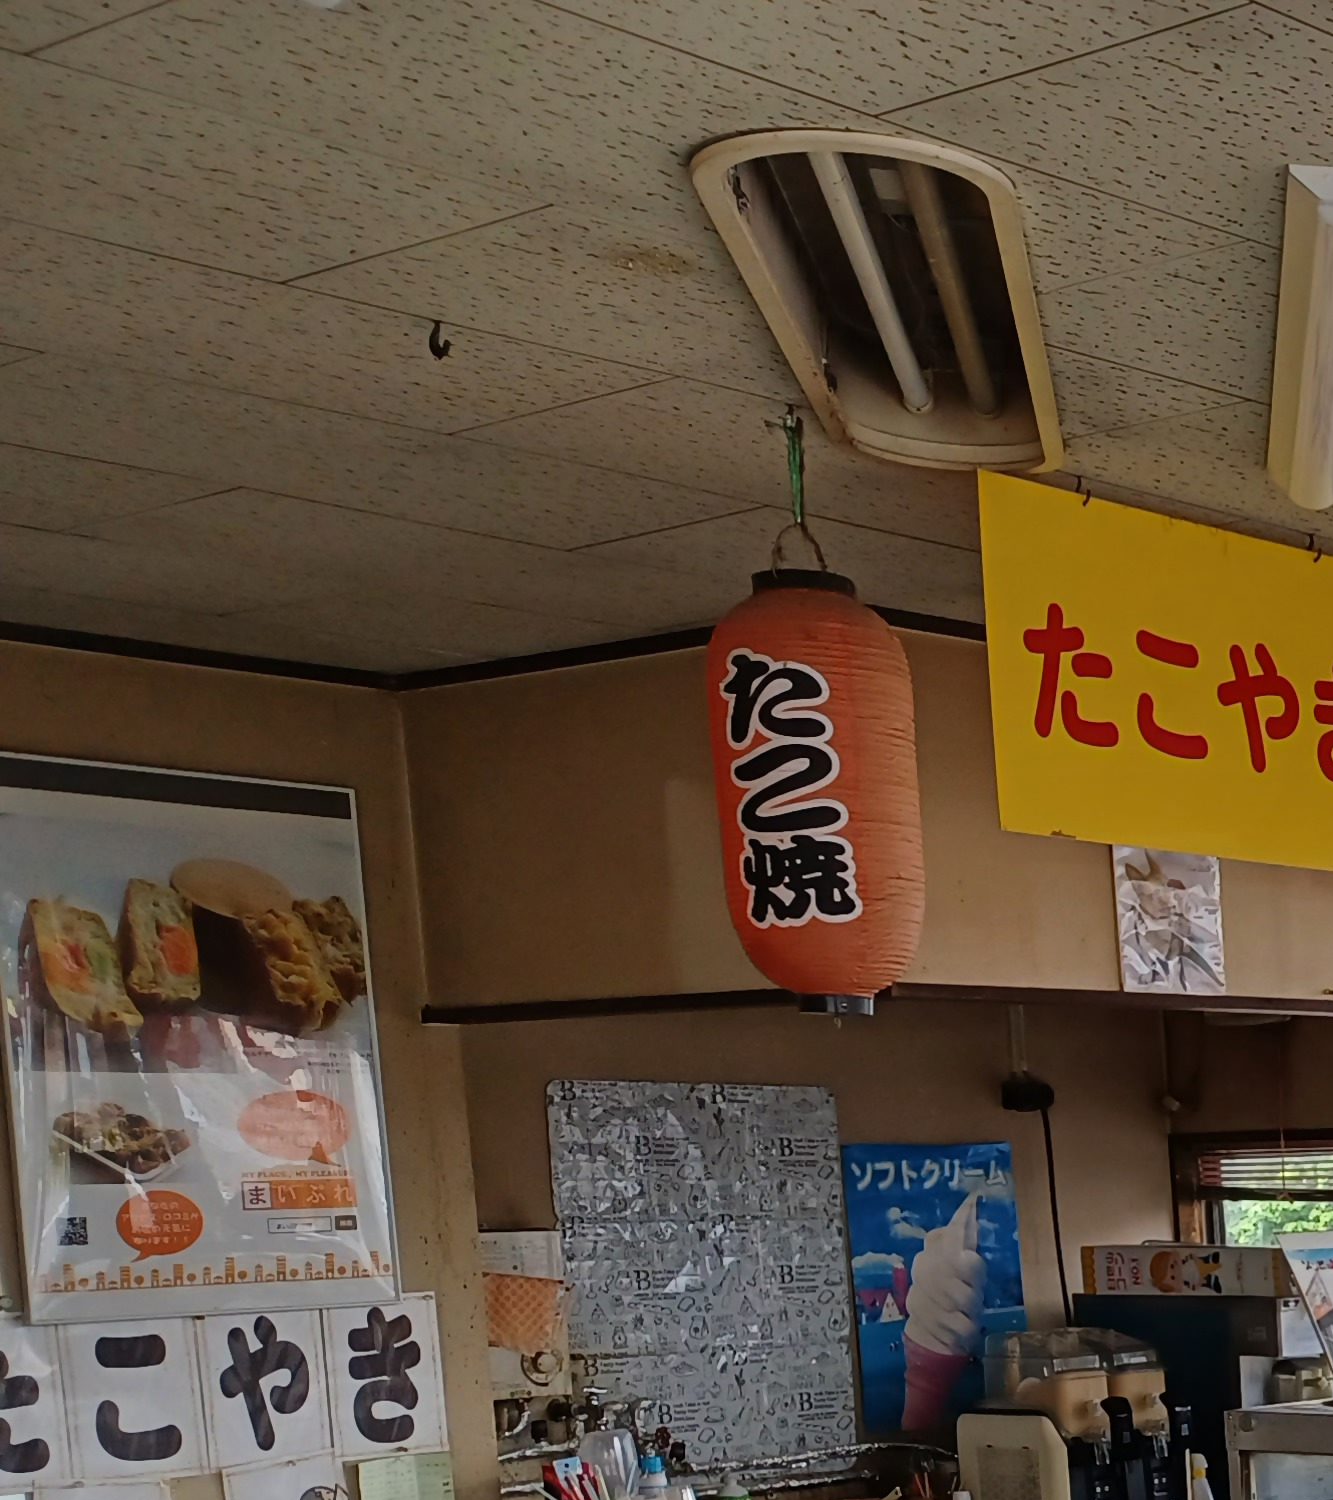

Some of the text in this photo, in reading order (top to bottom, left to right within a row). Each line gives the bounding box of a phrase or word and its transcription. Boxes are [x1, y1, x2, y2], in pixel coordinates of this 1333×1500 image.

[720, 650, 862, 925] たこ焼
[852, 1157, 1009, 1192] ソフトクリーム
